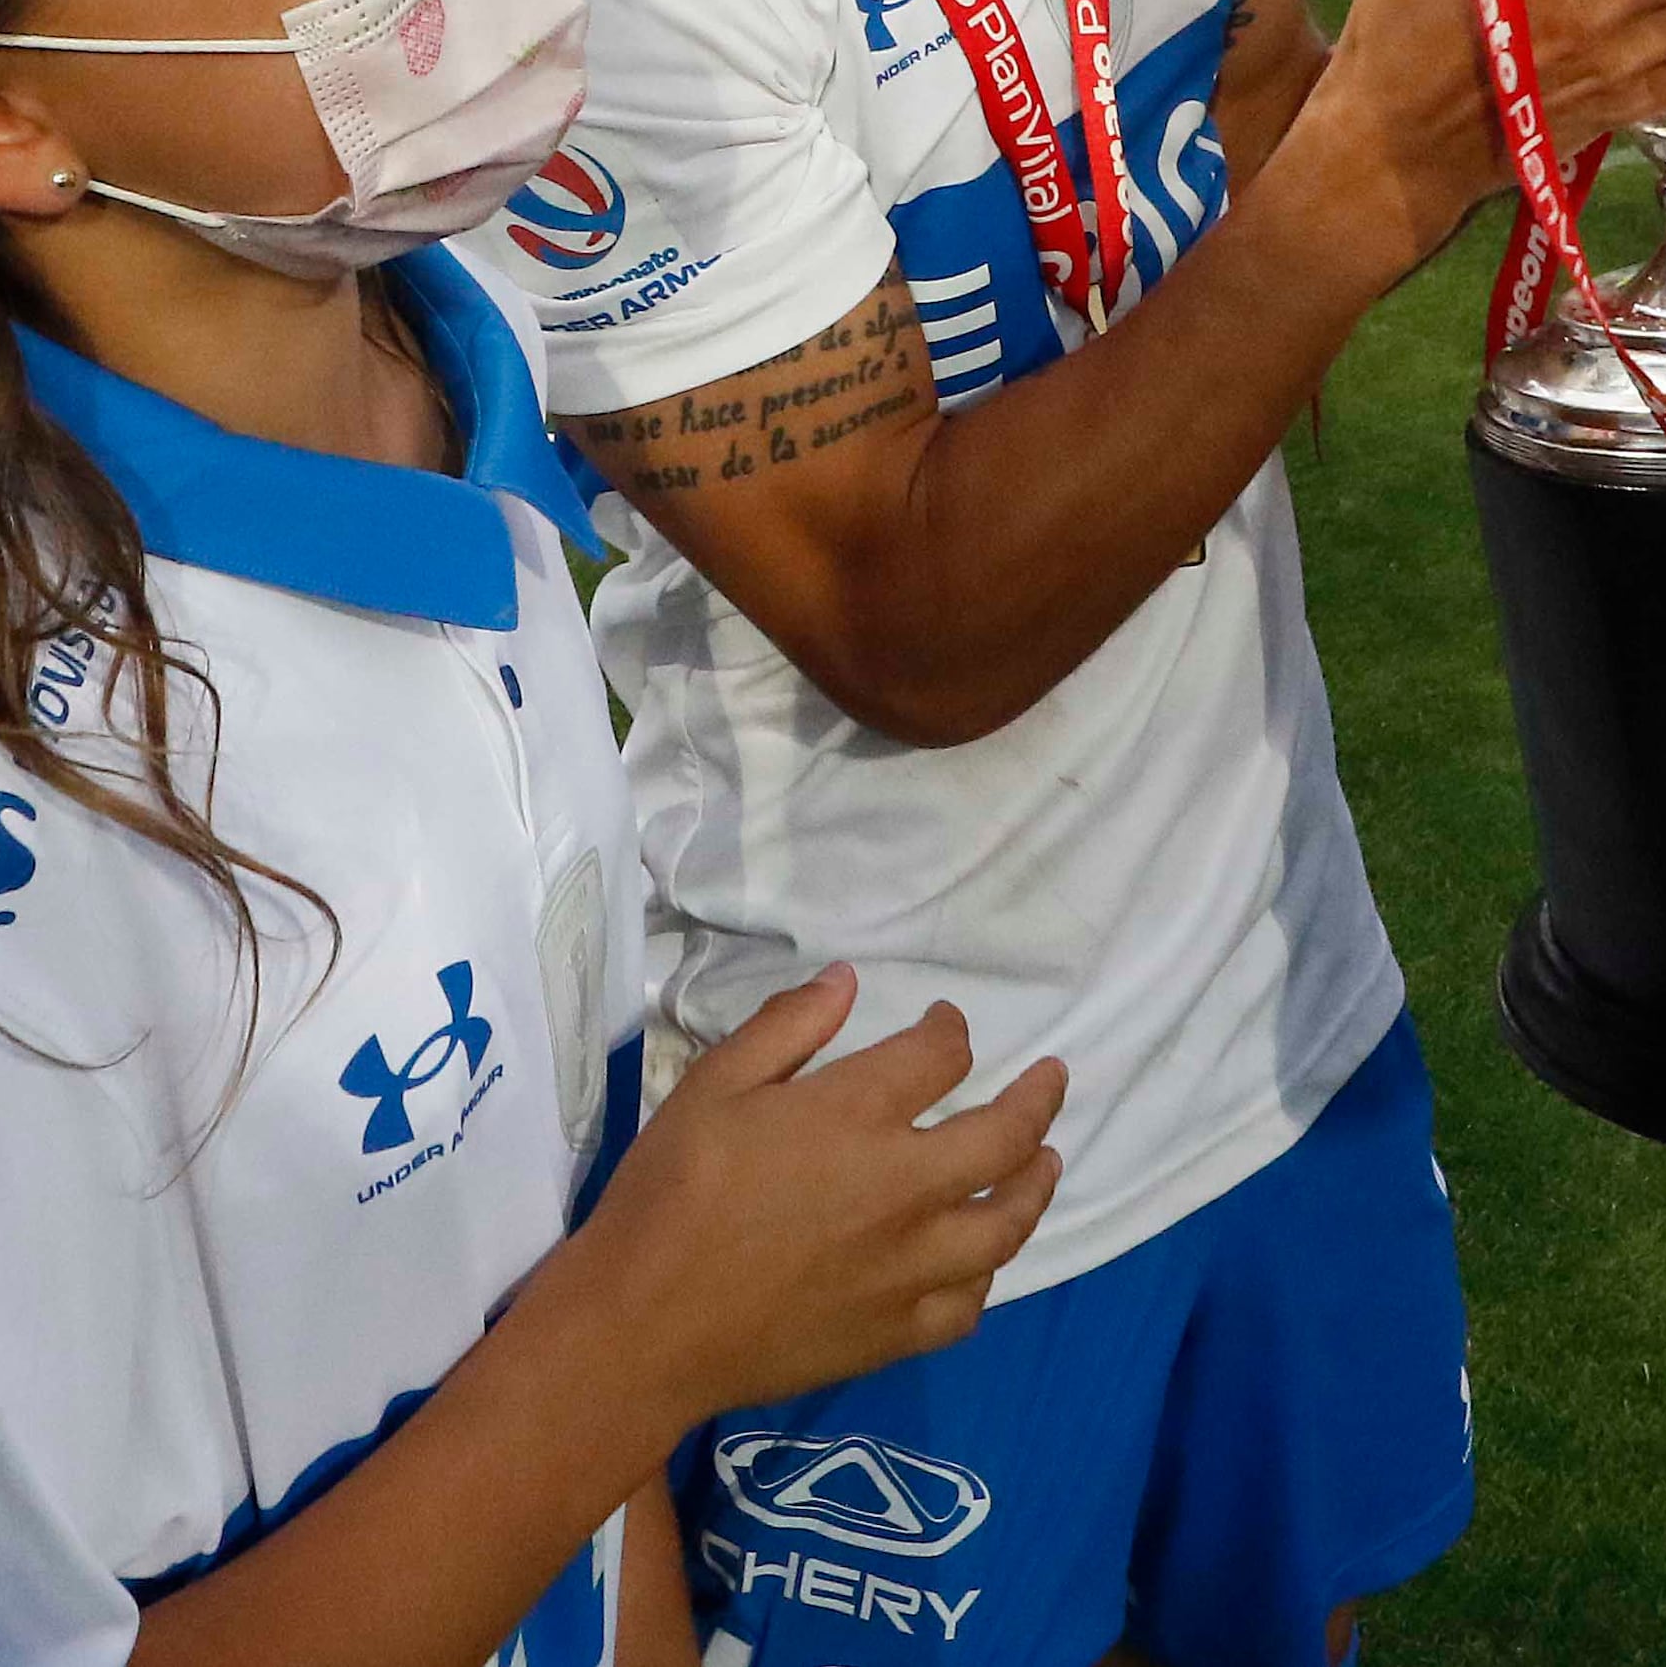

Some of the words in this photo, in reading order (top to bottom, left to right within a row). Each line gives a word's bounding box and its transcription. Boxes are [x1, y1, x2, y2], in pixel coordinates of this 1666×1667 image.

[875, 49, 922, 90] NDER
[967, 0, 1074, 223] PlanVital
[631, 413, 663, 442] se
[679, 396, 747, 437] hace
[759, 356, 886, 430] presente
[720, 440, 757, 482] de
[769, 424, 798, 464] la
[356, 1143, 445, 1205] UNDER
[700, 1527, 982, 1643] CHERY
